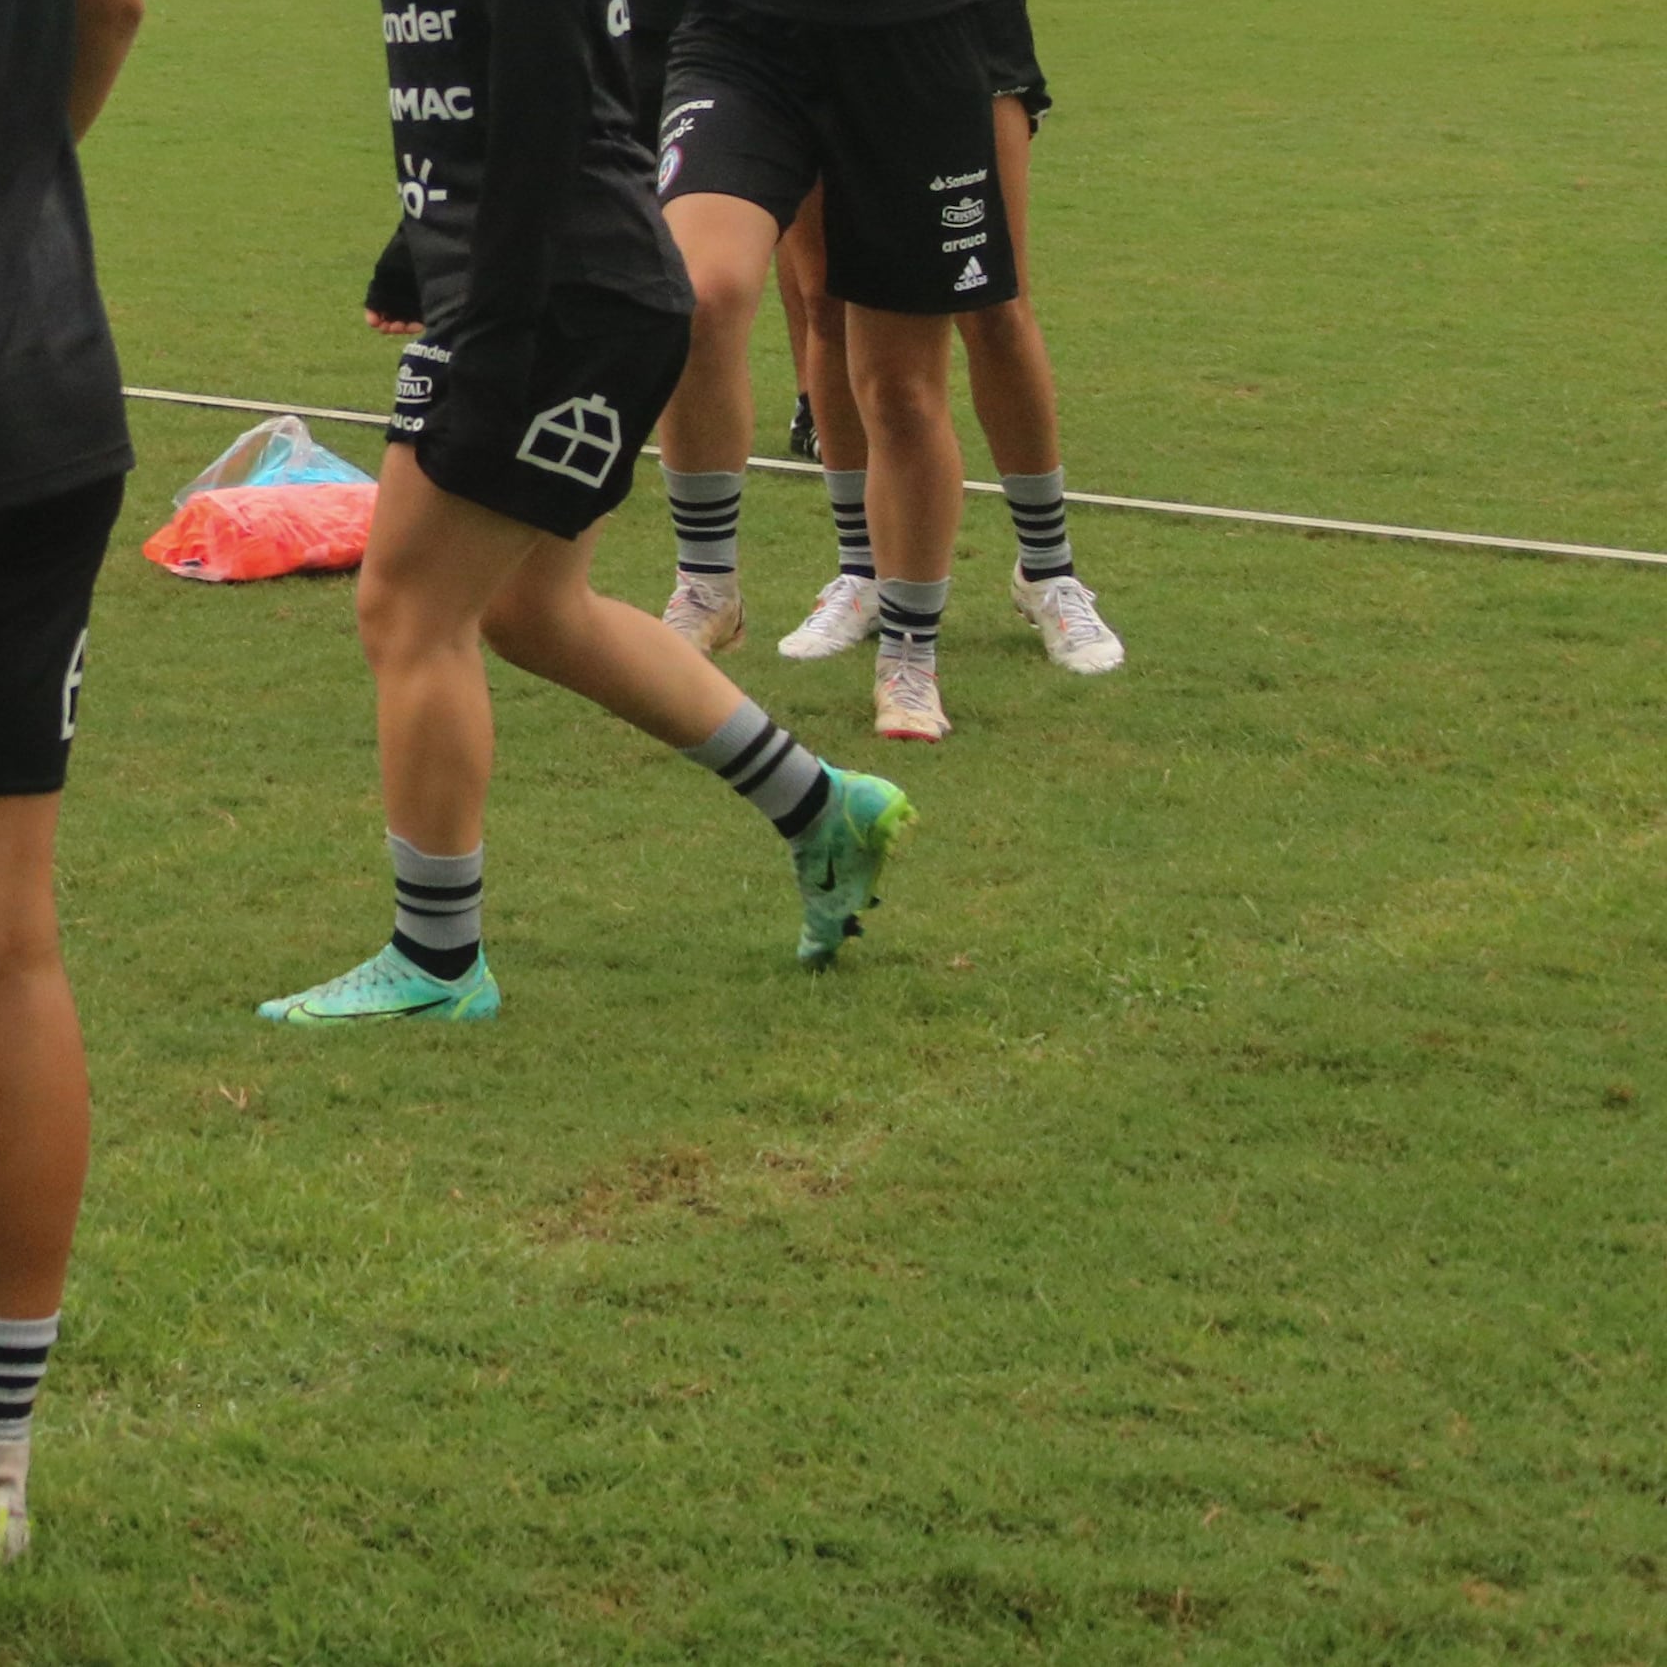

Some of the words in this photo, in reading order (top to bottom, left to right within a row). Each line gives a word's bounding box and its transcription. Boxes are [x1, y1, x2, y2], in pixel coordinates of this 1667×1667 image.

[946, 169, 987, 189] Santander
[947, 206, 983, 223] CRISTAL
[942, 232, 987, 253] arauco
[954, 274, 988, 291] adidas
